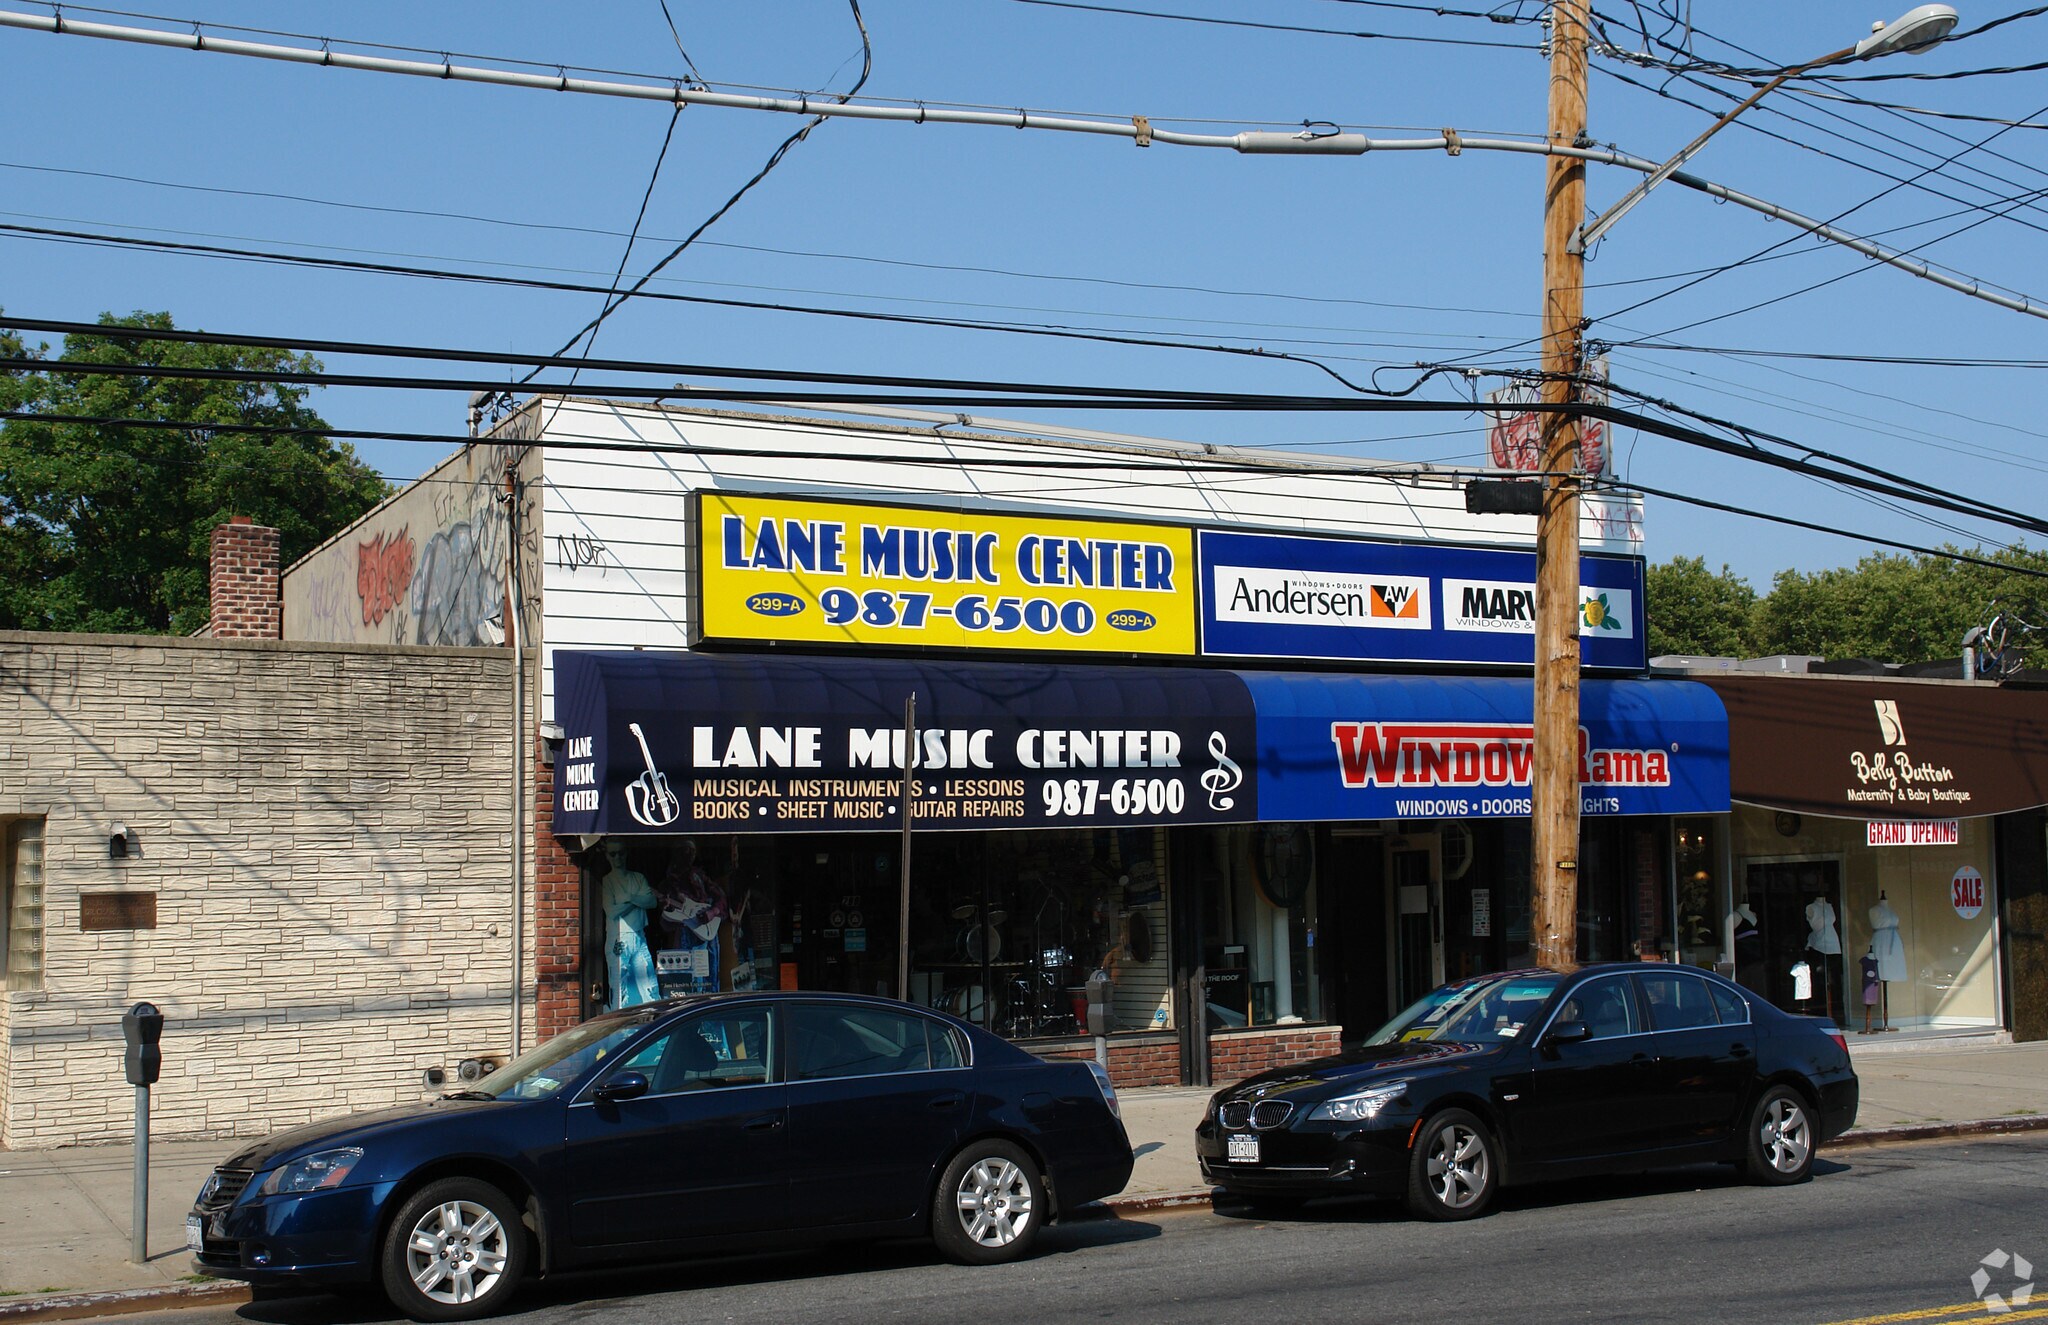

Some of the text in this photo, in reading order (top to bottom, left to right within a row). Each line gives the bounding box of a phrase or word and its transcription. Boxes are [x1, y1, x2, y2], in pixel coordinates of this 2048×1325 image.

[721, 514, 1177, 593] LANE MUSIC CENTER
[752, 597, 801, 612] 299-A
[1230, 577, 1365, 617] Andersen
[1462, 587, 1536, 621] MARV
[819, 588, 1096, 636] 987-6500
[1111, 612, 1152, 627] 299-A
[1456, 618, 1520, 629] WINDOWS
[568, 736, 593, 760] LANE
[693, 726, 1182, 769] LANE MUSIC CENTER
[566, 763, 596, 786] MUSIC
[1850, 751, 1953, 790] Belly Button
[693, 779, 782, 798] MUSICAL
[945, 779, 1025, 798] LESSONS
[1042, 778, 1185, 817] 987-6500
[1847, 788, 1971, 804] Maternity & Baby Boutique
[563, 789, 600, 812] CENTER
[693, 800, 750, 820] BOOKS
[777, 800, 827, 819] SHEET
[833, 800, 885, 819] MUSIC
[963, 799, 1025, 818] REPAIRS
[1396, 799, 1468, 816] WINDOWS
[1482, 798, 1532, 815] DOORS
[1869, 821, 1957, 844] GRAND OPENING
[1953, 878, 1982, 908] SALE
